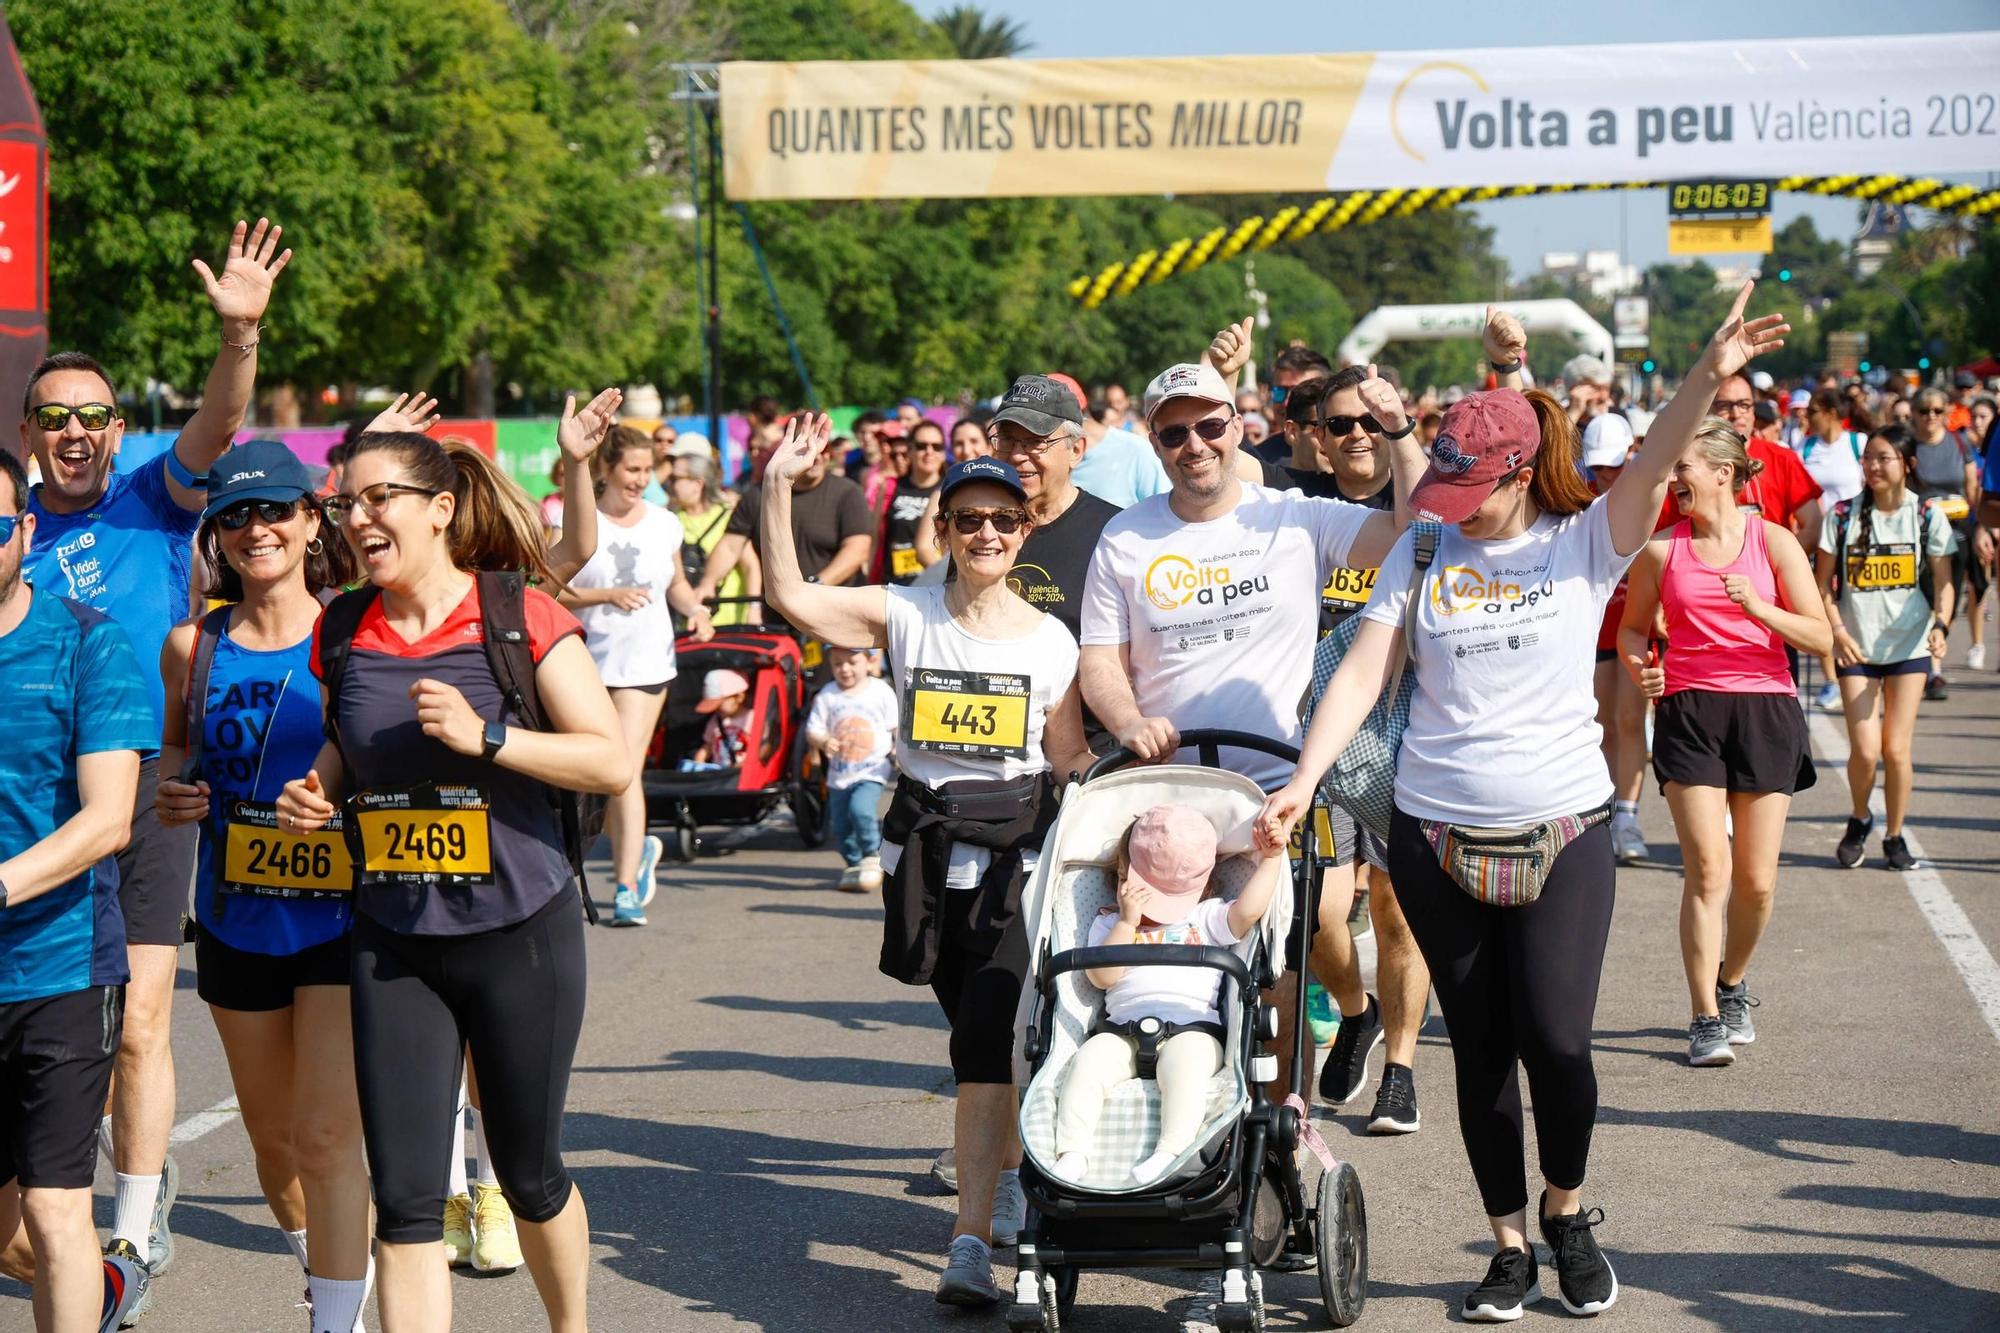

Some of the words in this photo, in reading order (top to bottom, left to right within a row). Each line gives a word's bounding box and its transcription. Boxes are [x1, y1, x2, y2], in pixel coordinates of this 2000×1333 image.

[768, 106, 926, 161] QUANTES
[942, 93, 1014, 152] MÉS
[1029, 101, 1154, 152] VOLTES
[1170, 99, 1303, 149] MILLOR
[1436, 98, 1569, 151] Volta
[1588, 112, 1617, 146] a
[1637, 104, 1734, 158] peu
[1749, 97, 1912, 143] València
[1926, 93, 1998, 137] 202
[1419, 508, 1444, 523] NORGE
[1166, 566, 1231, 590] Volta
[1863, 562, 1901, 580] 8106
[1197, 588, 1213, 605] a
[1222, 575, 1270, 606] peu
[1452, 580, 1521, 601] Volta
[1484, 603, 1502, 613] a
[1150, 623, 1191, 633] Quantes
[1429, 627, 1471, 640] Quantes
[206, 679, 287, 714] CAR
[940, 703, 998, 736] 443
[364, 794, 386, 804] Volta
[240, 806, 259, 818] Volta
[384, 821, 466, 862] 2469
[246, 838, 332, 880] 2466
